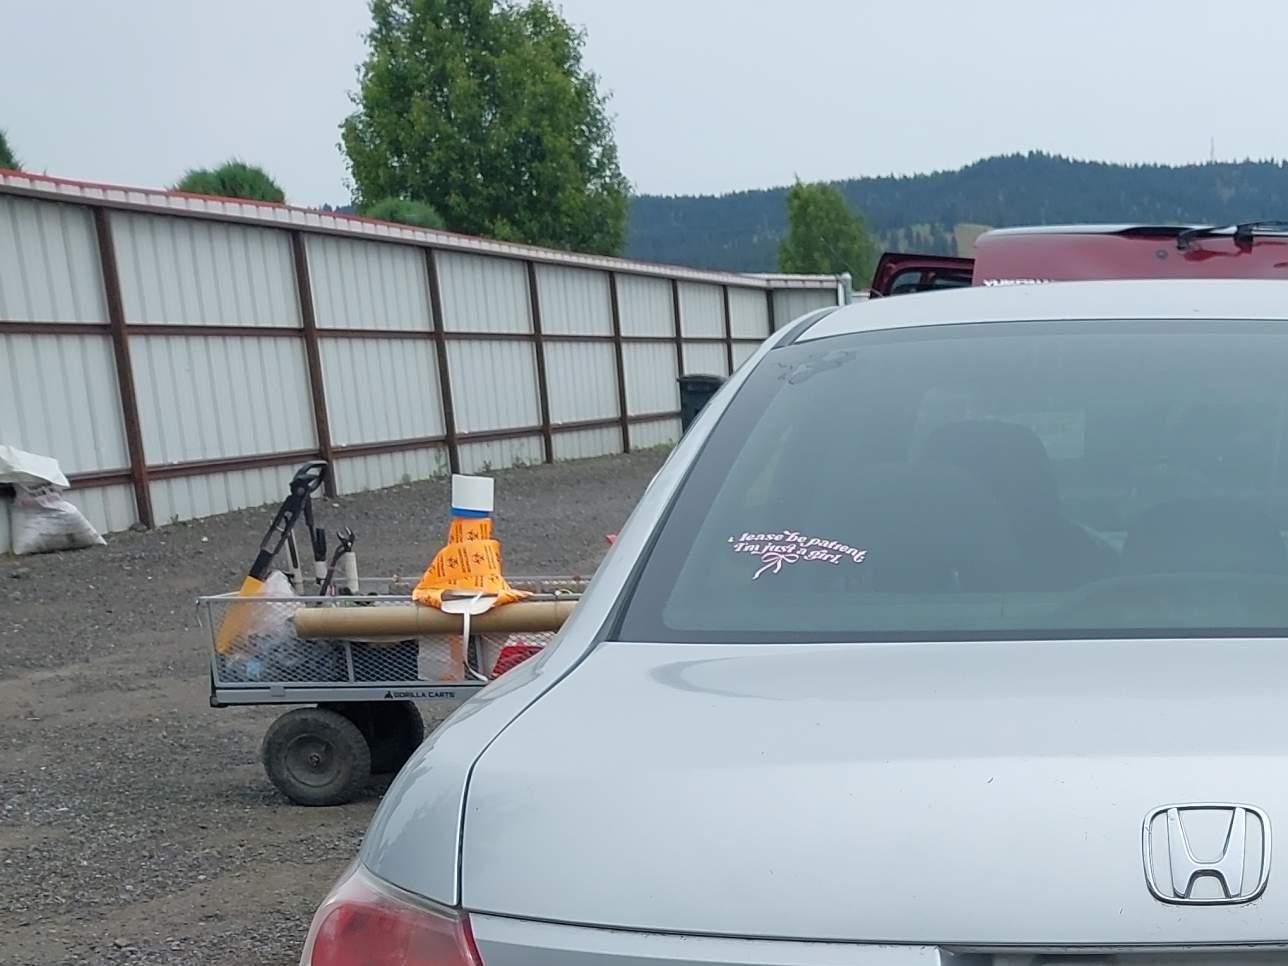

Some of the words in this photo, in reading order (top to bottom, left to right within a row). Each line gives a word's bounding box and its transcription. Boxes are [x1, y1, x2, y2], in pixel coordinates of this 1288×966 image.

[728, 532, 785, 543] lease
[783, 530, 808, 543] be
[733, 542, 761, 552] I'm
[751, 542, 797, 555] just
[796, 547, 808, 556] a
